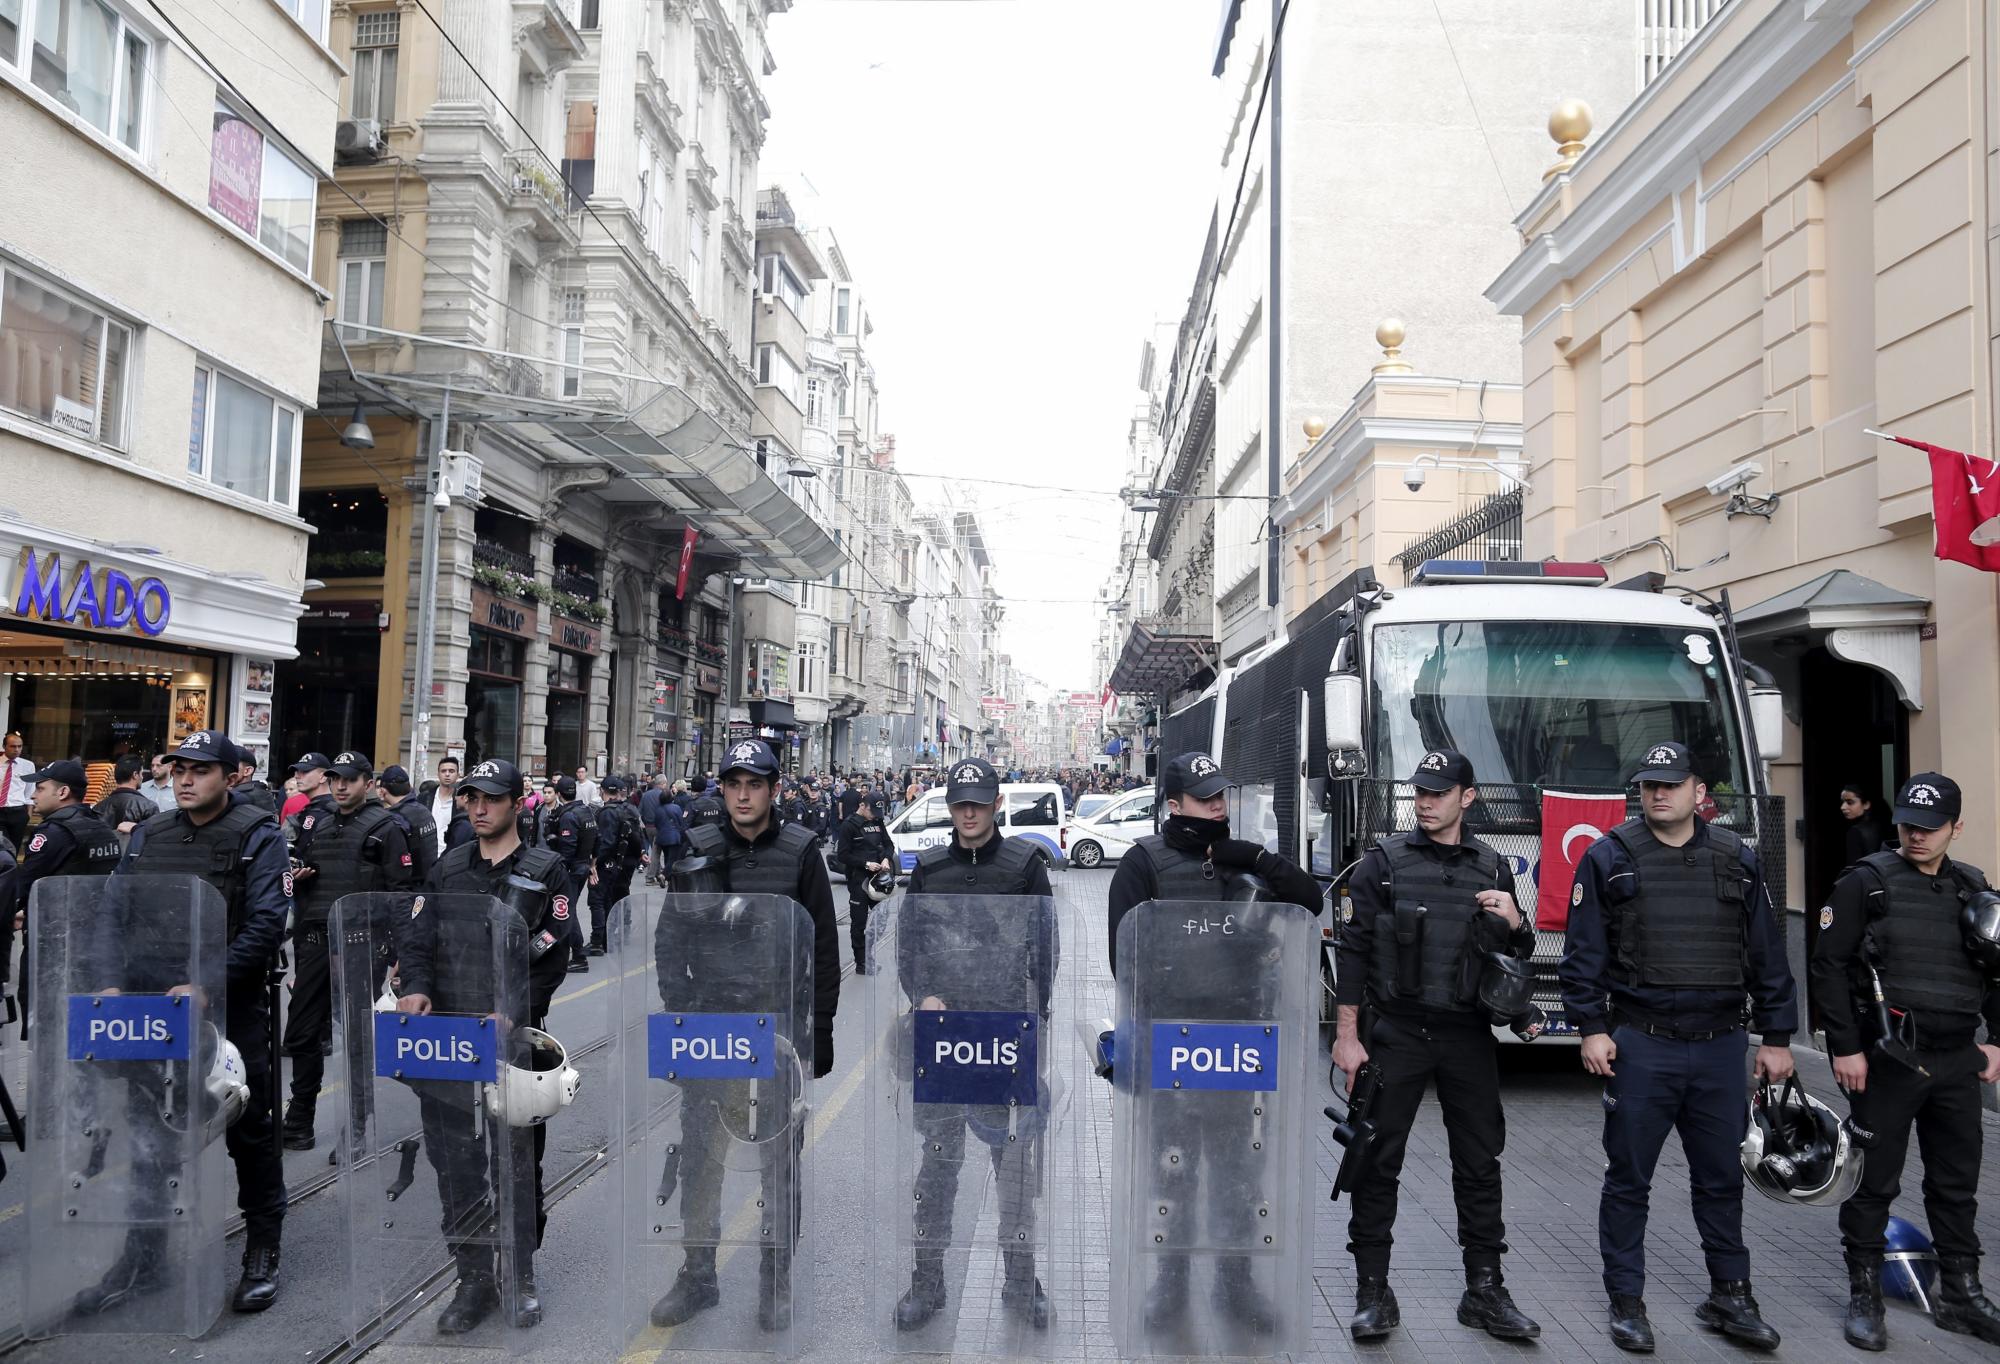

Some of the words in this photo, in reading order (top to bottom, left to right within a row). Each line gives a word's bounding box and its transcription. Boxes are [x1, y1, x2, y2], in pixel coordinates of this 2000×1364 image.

[9, 546, 171, 637] MADO
[1648, 757, 1671, 765] POLİS
[957, 776, 979, 784] POLİS
[1909, 796, 1934, 806] POLİS
[89, 842, 119, 859] POLİS
[917, 835, 946, 847] POLİS
[90, 1014, 168, 1042] POLİS
[397, 1035, 474, 1062] POLİS
[672, 1033, 751, 1060] POLİS
[935, 1037, 1018, 1066] POLİS
[1171, 1043, 1260, 1073] POLİS
